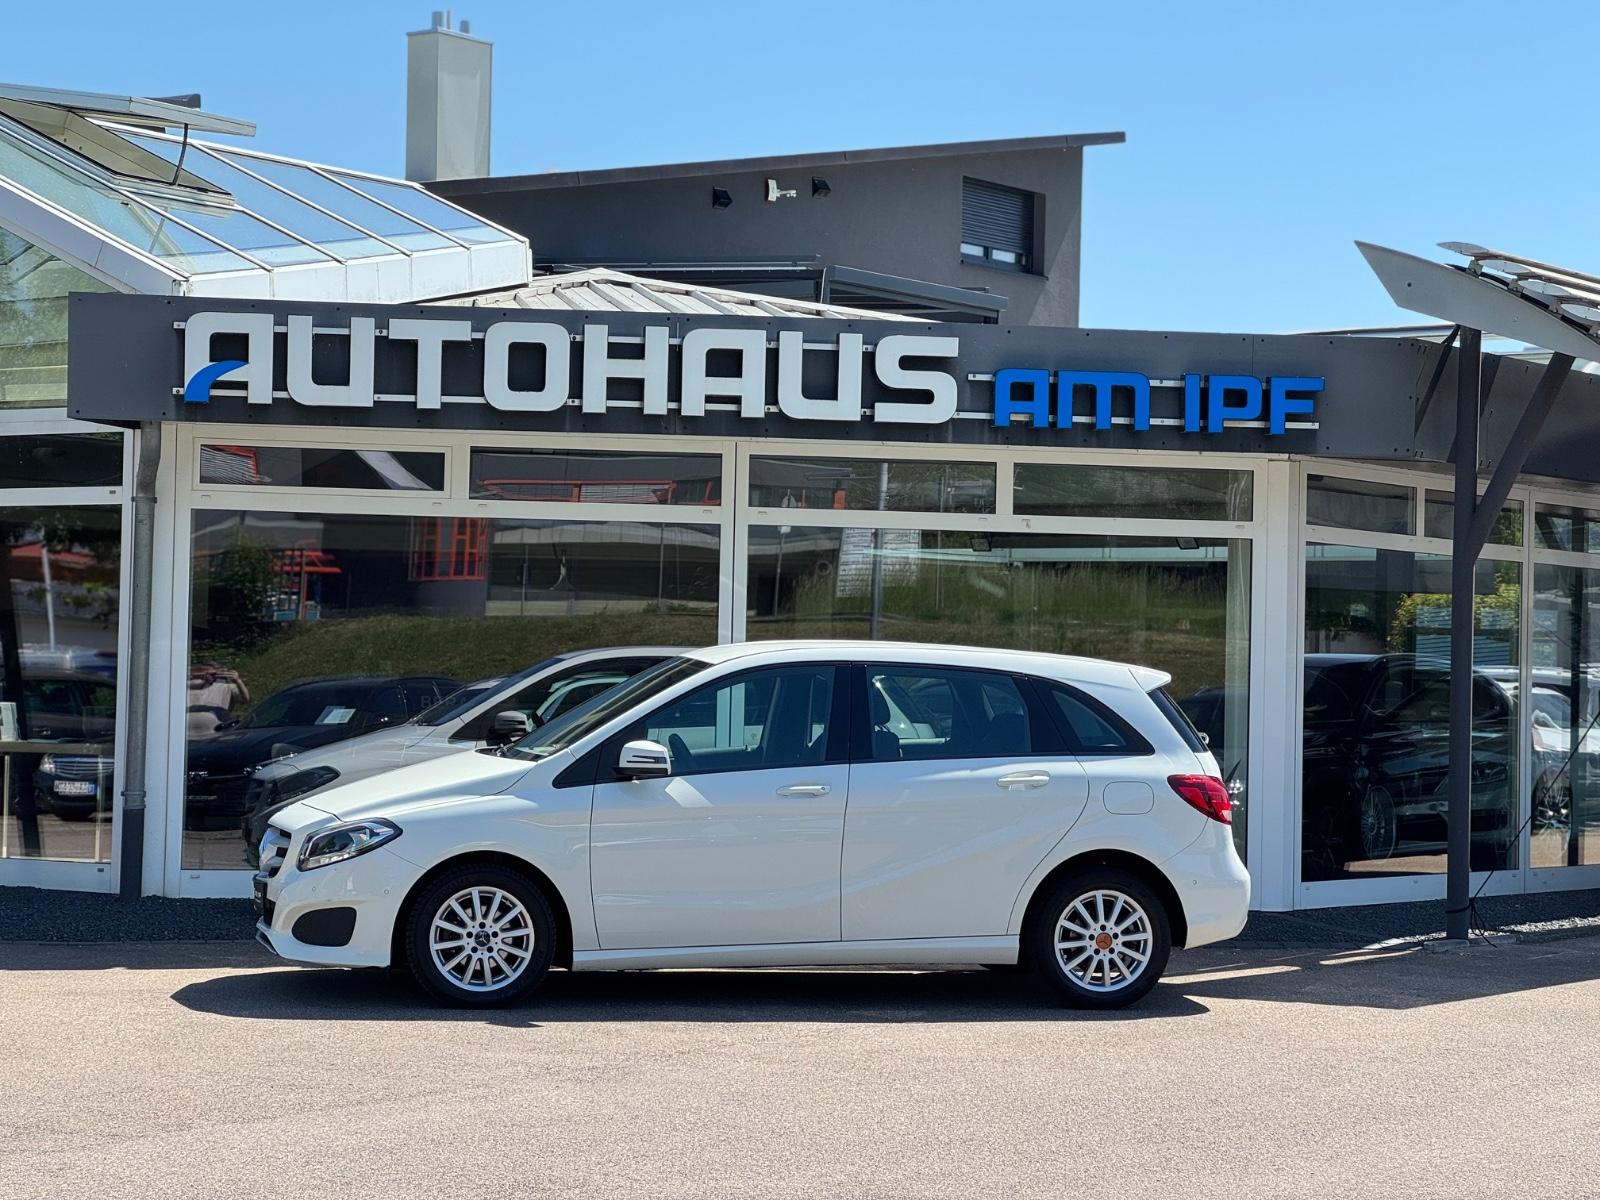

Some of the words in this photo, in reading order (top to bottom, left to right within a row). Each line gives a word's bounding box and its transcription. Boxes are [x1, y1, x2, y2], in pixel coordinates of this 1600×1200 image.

[184, 312, 959, 424] AUTOHAUS
[994, 368, 1150, 431] AM
[1183, 373, 1325, 435] IPF
